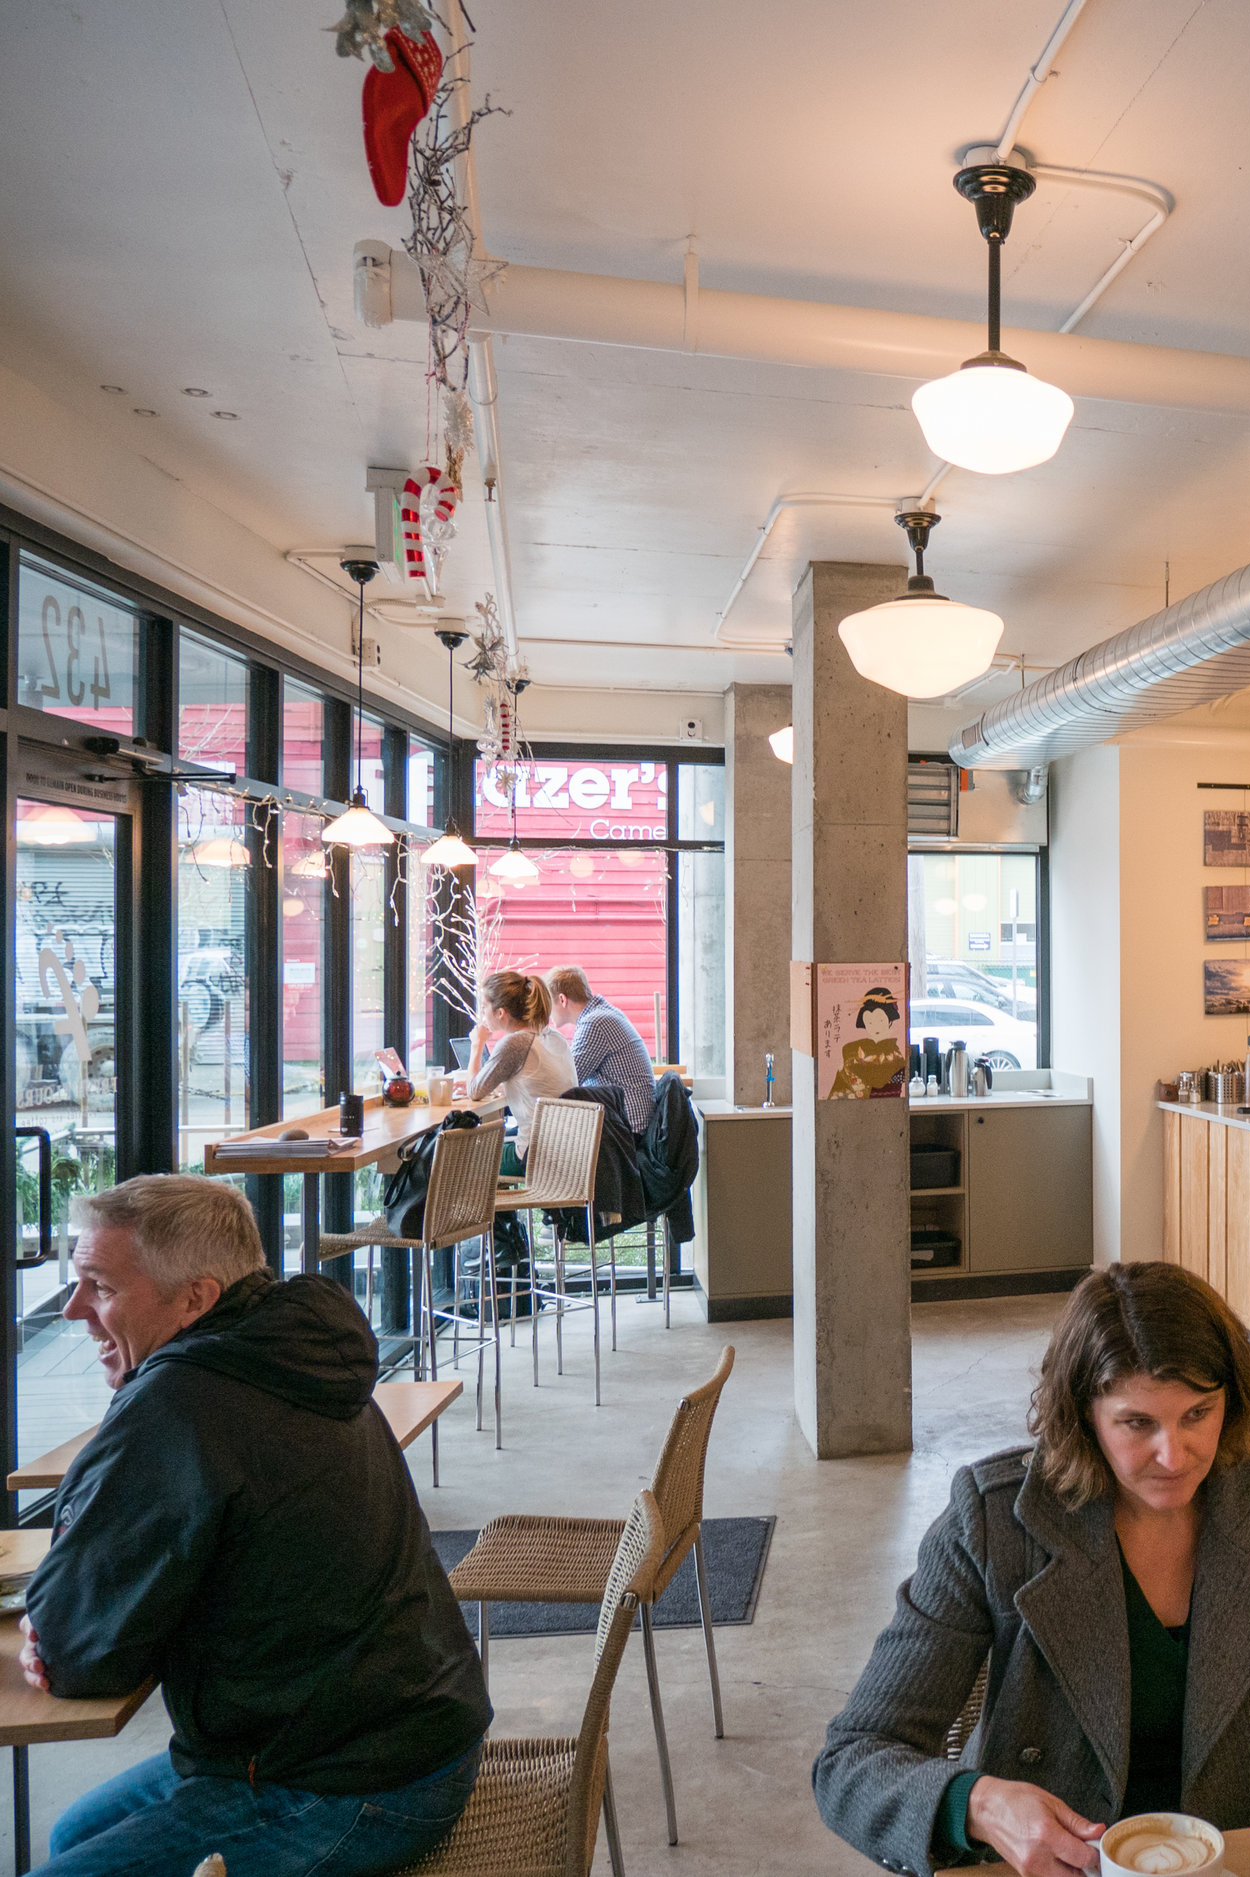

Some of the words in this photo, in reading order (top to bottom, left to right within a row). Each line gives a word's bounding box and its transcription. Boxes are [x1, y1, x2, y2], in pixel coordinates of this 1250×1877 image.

[65, 782, 77, 793] OPEN
[475, 763, 667, 810] azer'
[824, 1019, 833, 1059] あります
